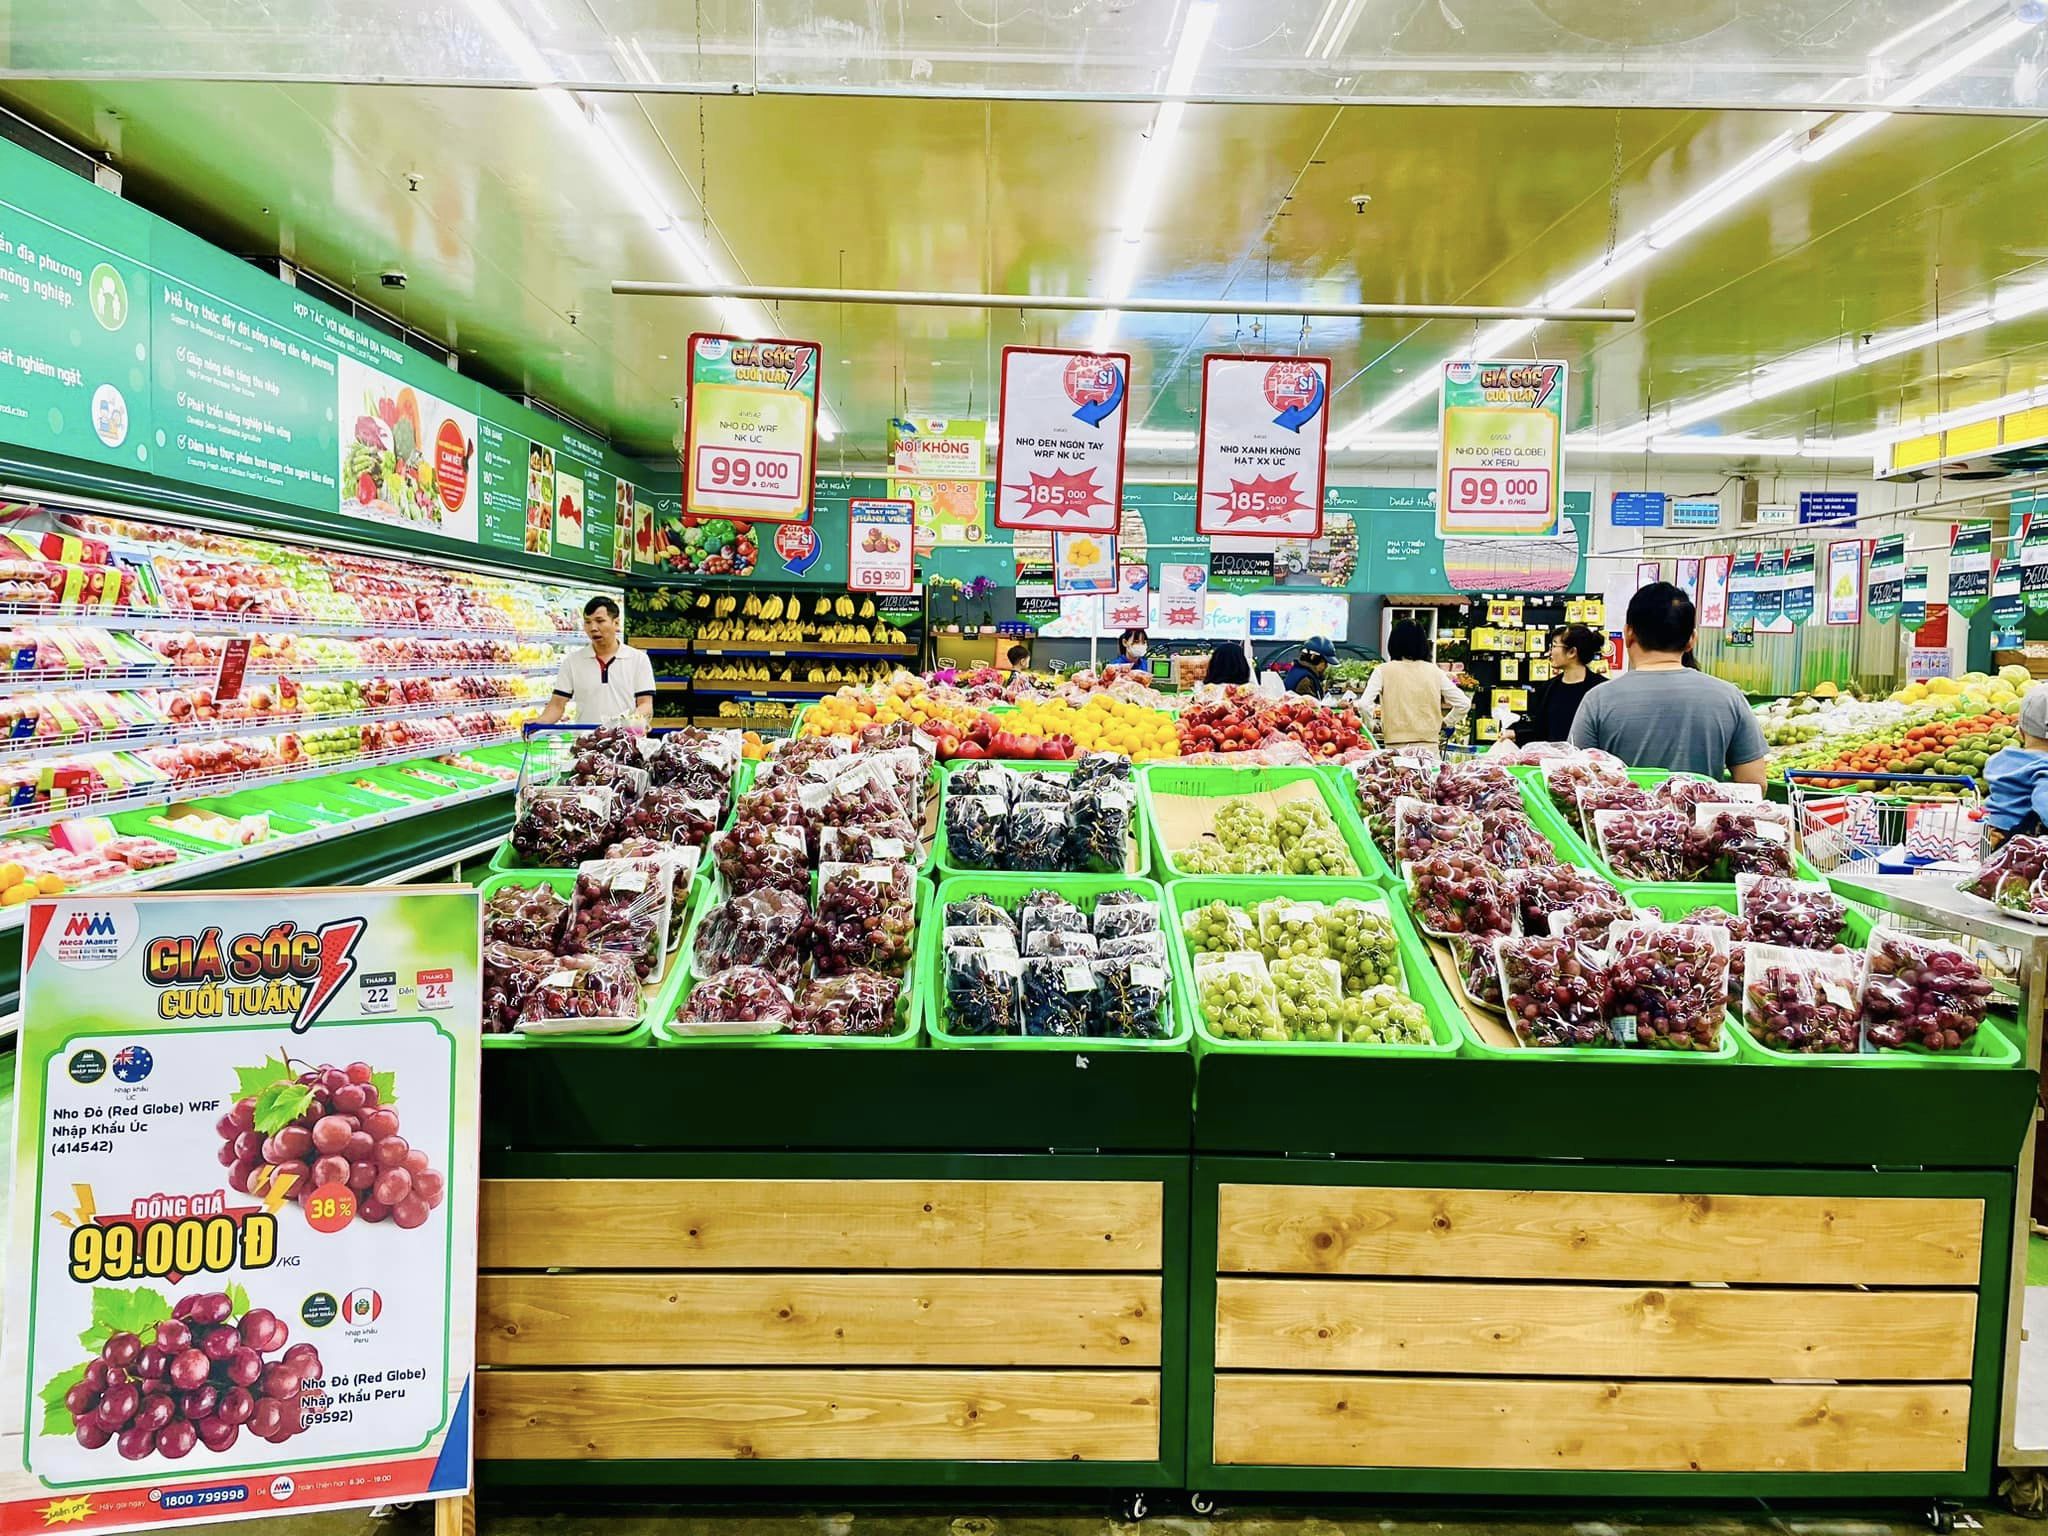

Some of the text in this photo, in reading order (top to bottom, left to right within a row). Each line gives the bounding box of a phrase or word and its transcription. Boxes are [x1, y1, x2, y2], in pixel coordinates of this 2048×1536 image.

[17, 243, 82, 286] địa phương
[310, 309, 325, 327] TÁC
[731, 345, 796, 369] GIÁ SỐC
[16, 356, 55, 378] nghiêm
[1481, 367, 1543, 389] GIÁ SỐC
[720, 421, 739, 430] NHO
[757, 424, 778, 433] WRF
[734, 433, 747, 442] NK
[1016, 437, 1035, 446] NHO
[1038, 439, 1057, 447] ĐEN
[1088, 441, 1104, 450] TAY
[922, 439, 969, 454] KHÔNG
[1034, 450, 1055, 458] WRF
[1057, 451, 1069, 459] NK
[1220, 445, 1239, 454] NHO
[1242, 446, 1267, 454] XANH
[1456, 447, 1474, 455] NHO
[1492, 447, 1512, 456] (RED
[1514, 447, 1546, 457] GLOBE)
[1257, 457, 1270, 465] XX
[1481, 459, 1519, 467] XX PERU
[756, 461, 788, 479] 000
[956, 485, 969, 493] 20
[1067, 490, 1087, 499] 000
[1506, 479, 1538, 496] 000
[1268, 496, 1287, 505] 000
[148, 922, 320, 983] GIÁ SỐC
[160, 979, 302, 1018] CUỐI TUẦN
[368, 988, 388, 1003] 22
[426, 984, 446, 998] 24
[53, 1100, 220, 1120] Nho Đỏ (Red Globe) WRF
[52, 1120, 148, 1139] Nhập Khẩu Úc
[52, 1141, 113, 1157] (414542)
[134, 1190, 223, 1220] ĐỒNG GIÁ
[311, 1198, 335, 1218] 38
[276, 1256, 300, 1268] /KG
[302, 1368, 426, 1389] Nho Đỏ (Red Globe)
[301, 1388, 406, 1408] Nhập Khẩu Peru
[301, 1410, 353, 1427] (69592)
[164, 1489, 244, 1507] 1800 799998
